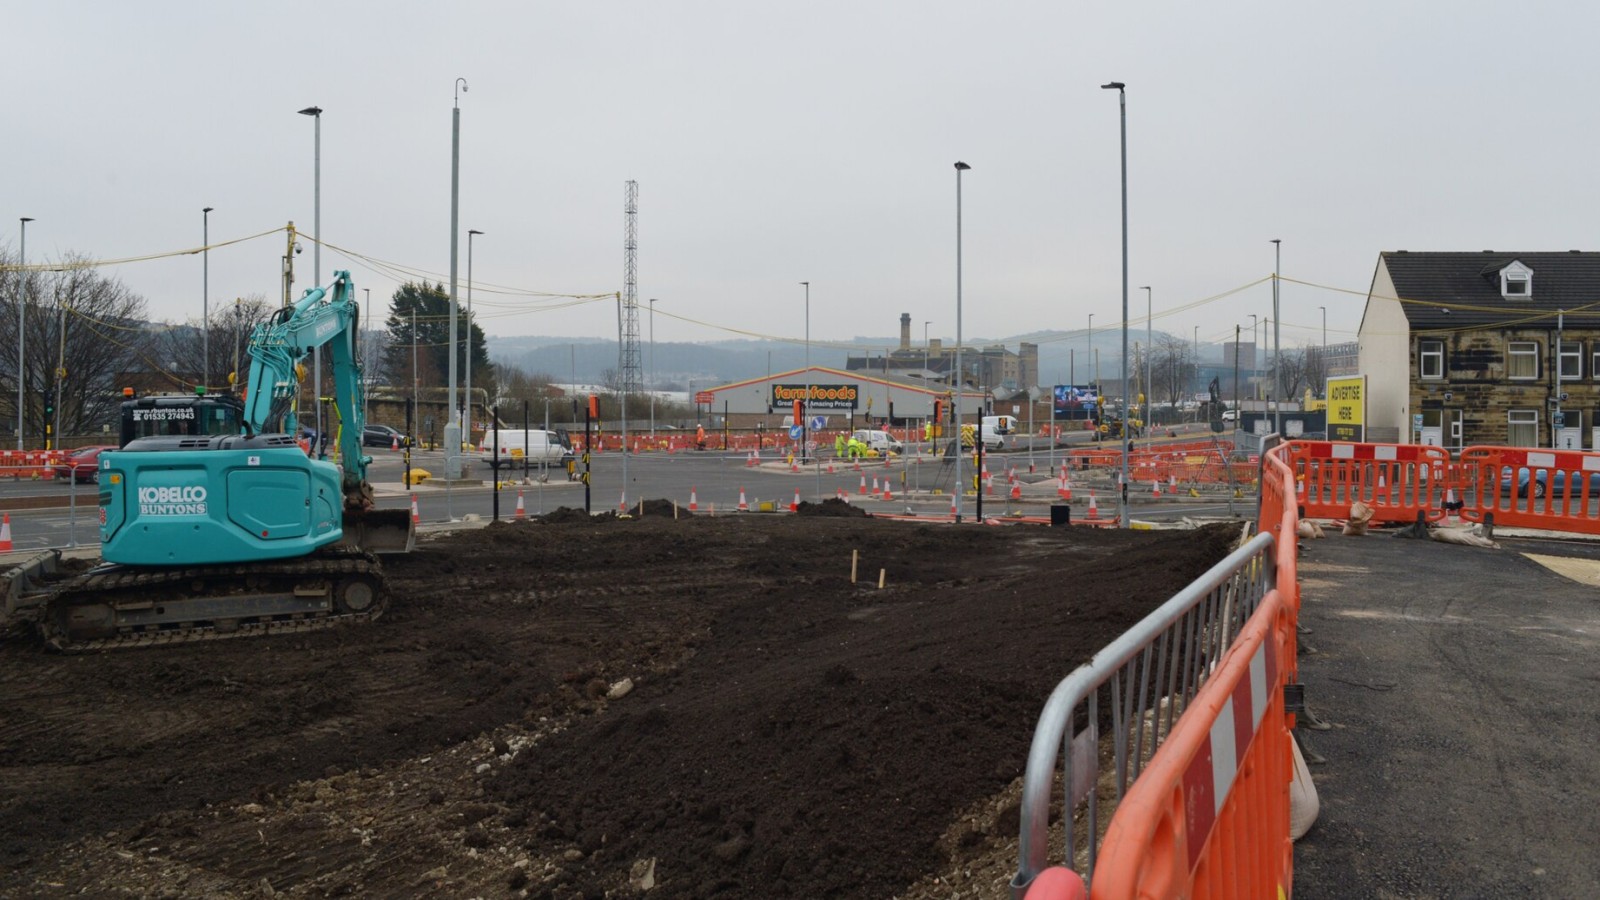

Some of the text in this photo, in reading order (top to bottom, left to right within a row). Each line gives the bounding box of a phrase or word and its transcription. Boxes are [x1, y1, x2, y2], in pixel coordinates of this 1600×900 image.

[776, 386, 856, 399] farmfoods
[1332, 386, 1360, 400] ADVERTISE
[1338, 407, 1352, 420] HERE
[138, 486, 207, 502] KOBELCO
[141, 504, 206, 514] BUNTONS
